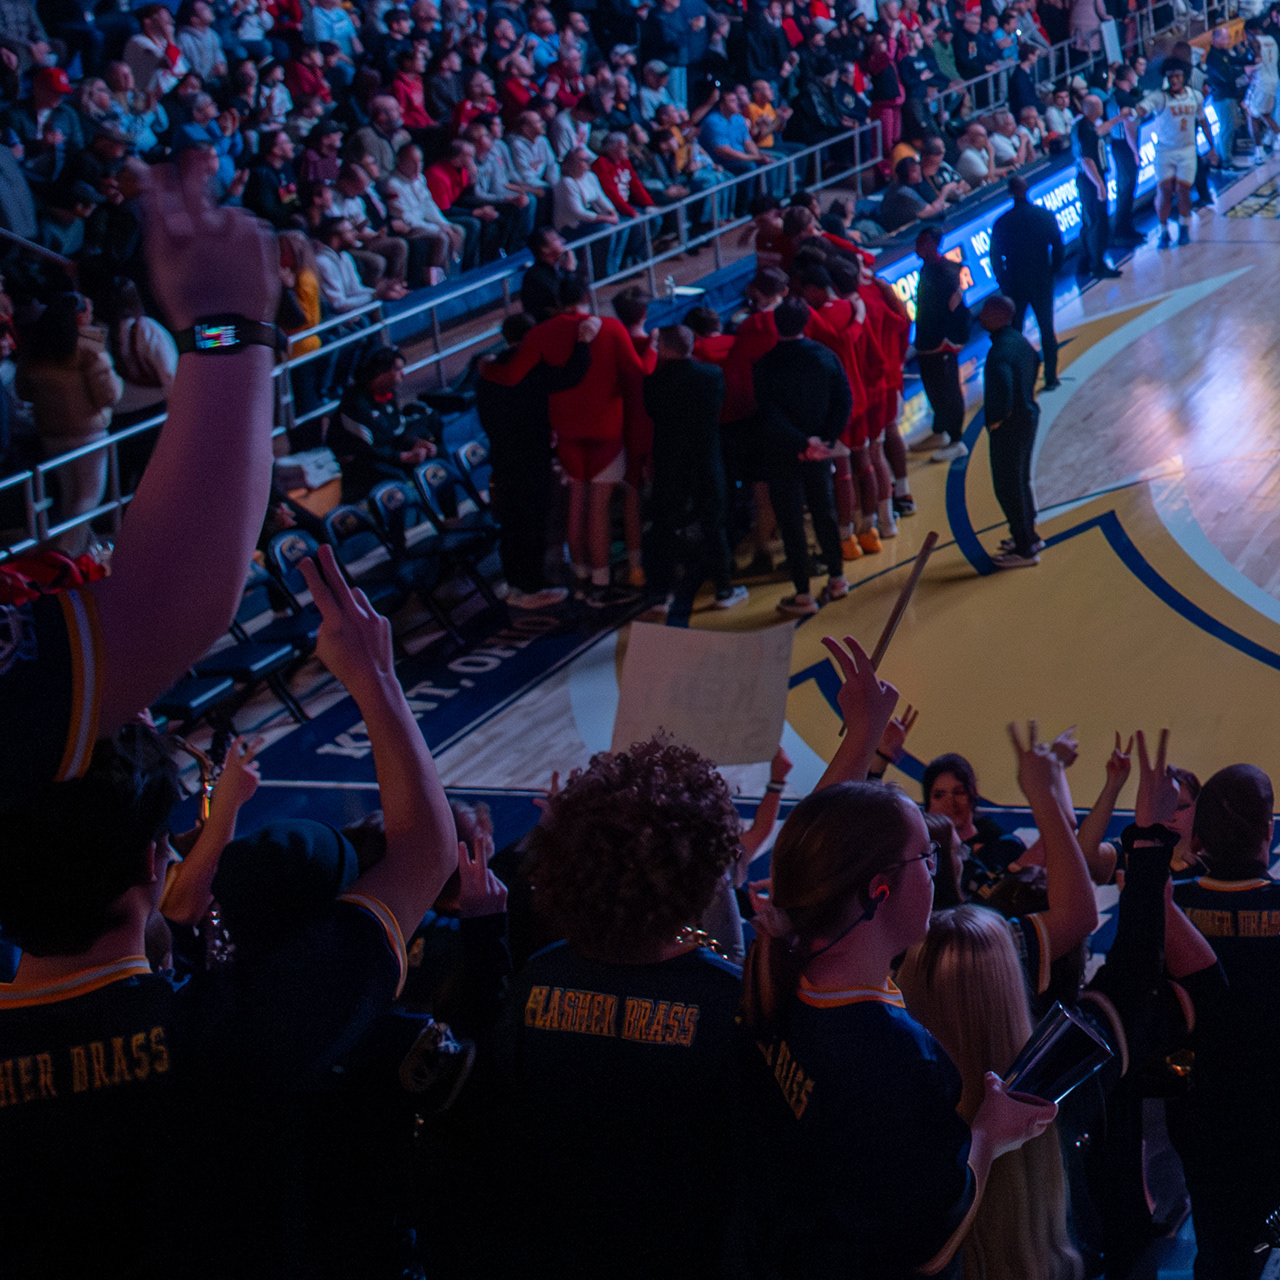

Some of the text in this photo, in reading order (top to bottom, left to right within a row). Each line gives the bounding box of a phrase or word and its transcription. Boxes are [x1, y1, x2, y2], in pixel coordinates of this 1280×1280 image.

[523, 985, 701, 1049] FLASHER BRASS
[69, 1025, 172, 1094] BRASS
